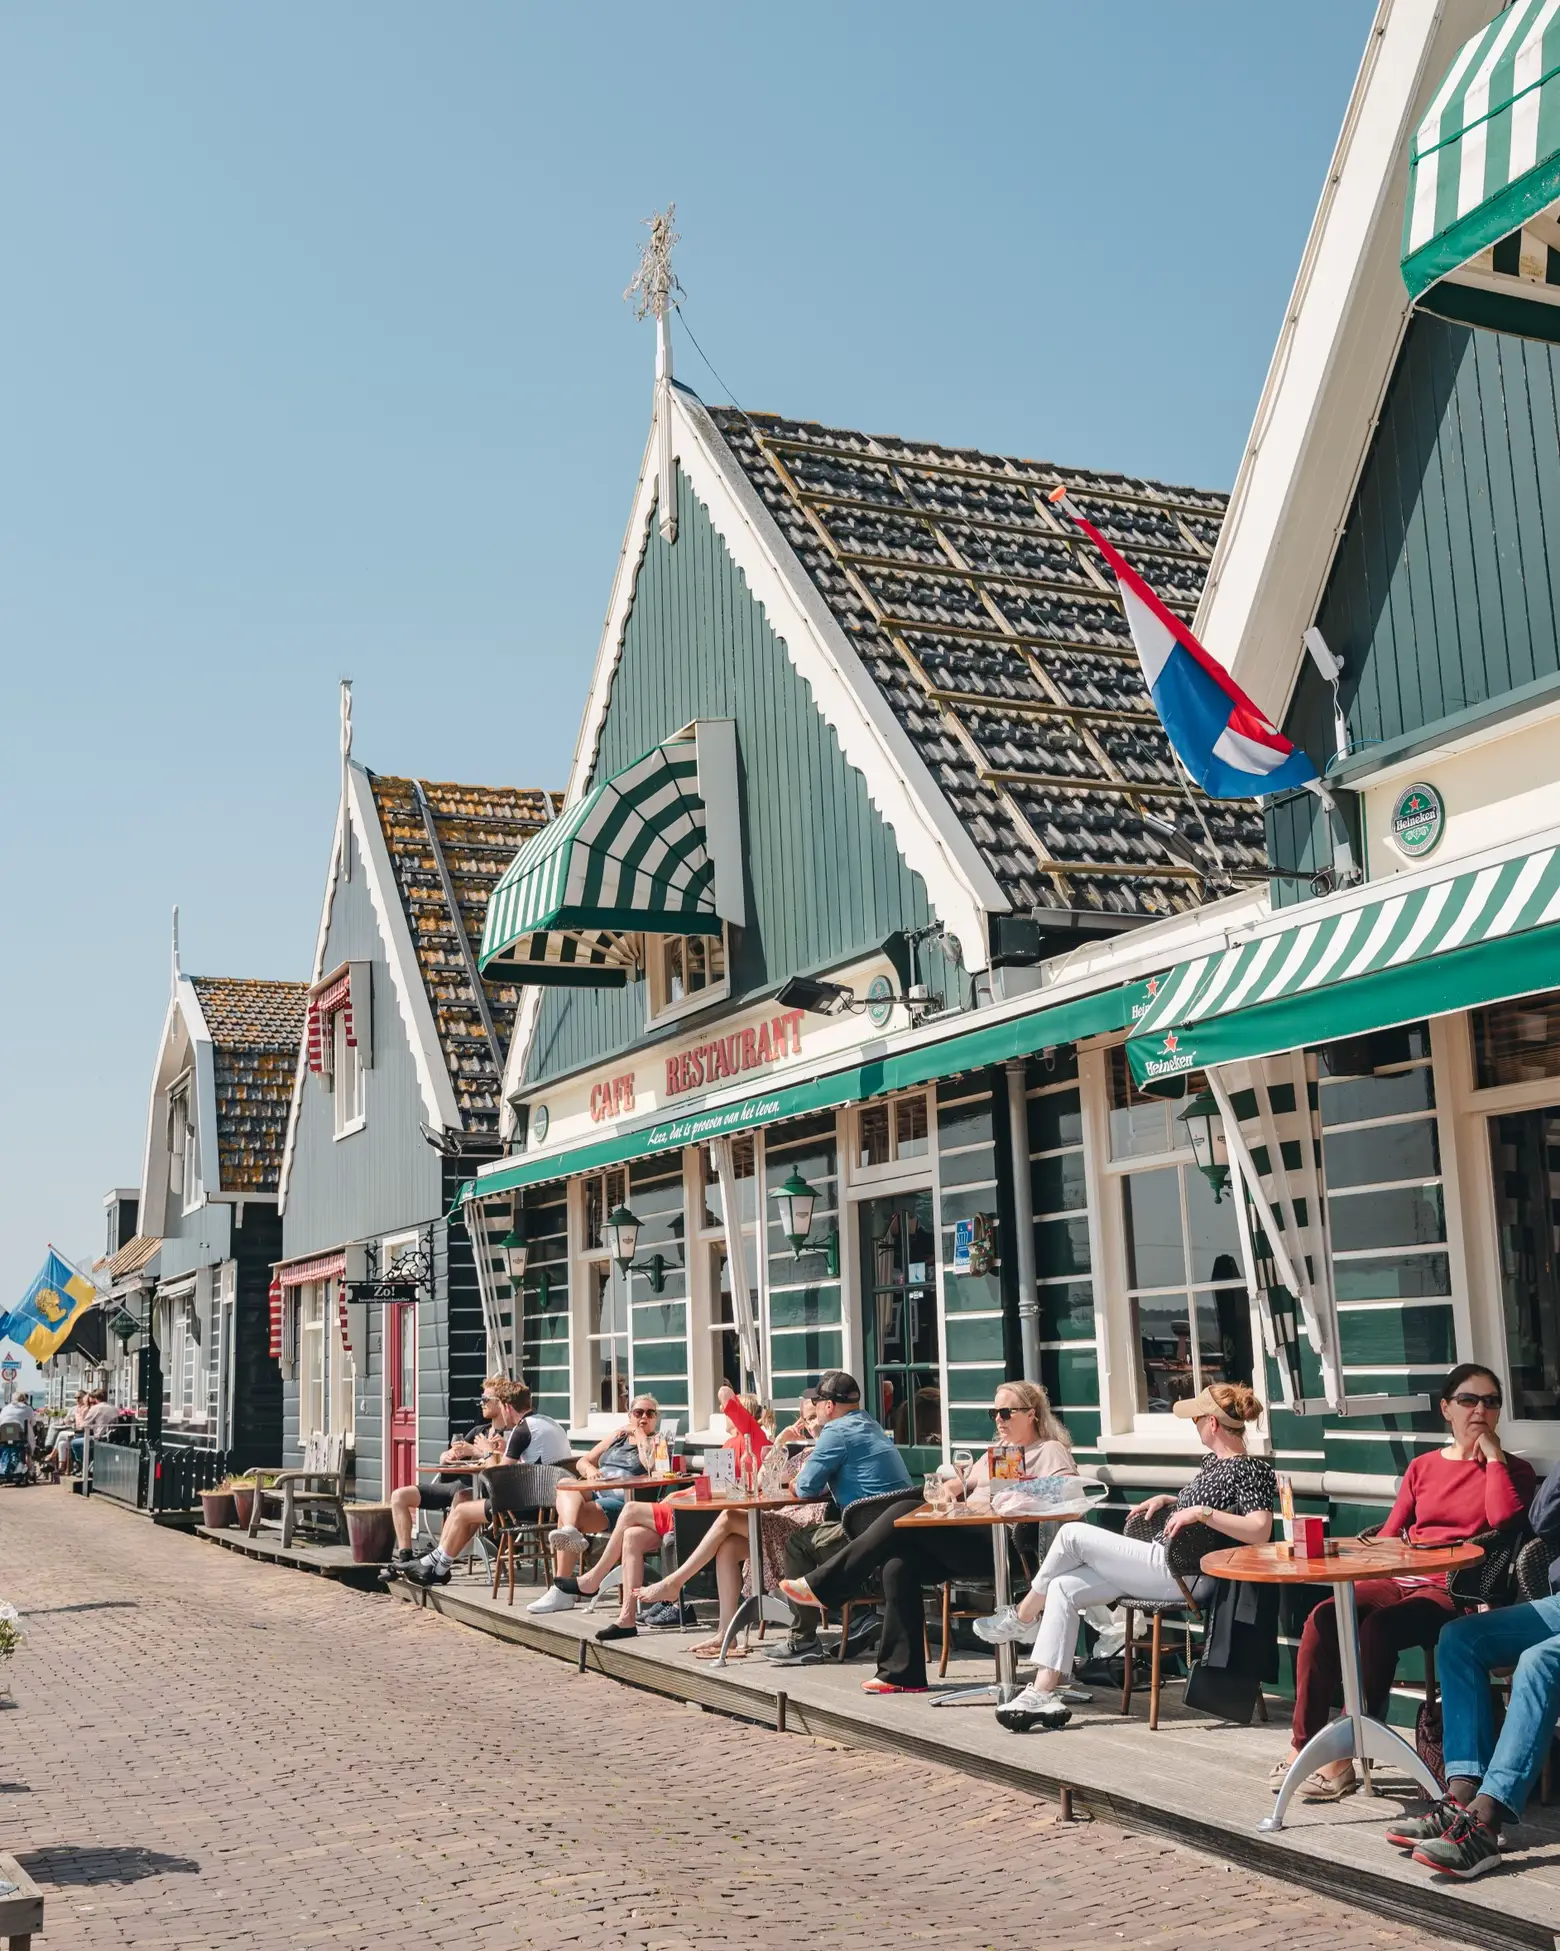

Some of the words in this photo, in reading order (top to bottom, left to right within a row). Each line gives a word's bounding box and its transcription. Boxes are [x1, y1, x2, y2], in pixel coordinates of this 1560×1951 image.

[1396, 809, 1436, 830] Heineken
[590, 1073, 635, 1122] CAFE
[665, 1009, 805, 1096] RESTAURANT
[1145, 1053, 1195, 1076] Heineken
[669, 1124, 682, 1140] dat
[683, 1120, 691, 1137] is
[691, 1113, 723, 1140] proeven
[724, 1111, 738, 1125] van
[740, 1102, 755, 1121] het
[374, 1286, 395, 1297] Zo!
